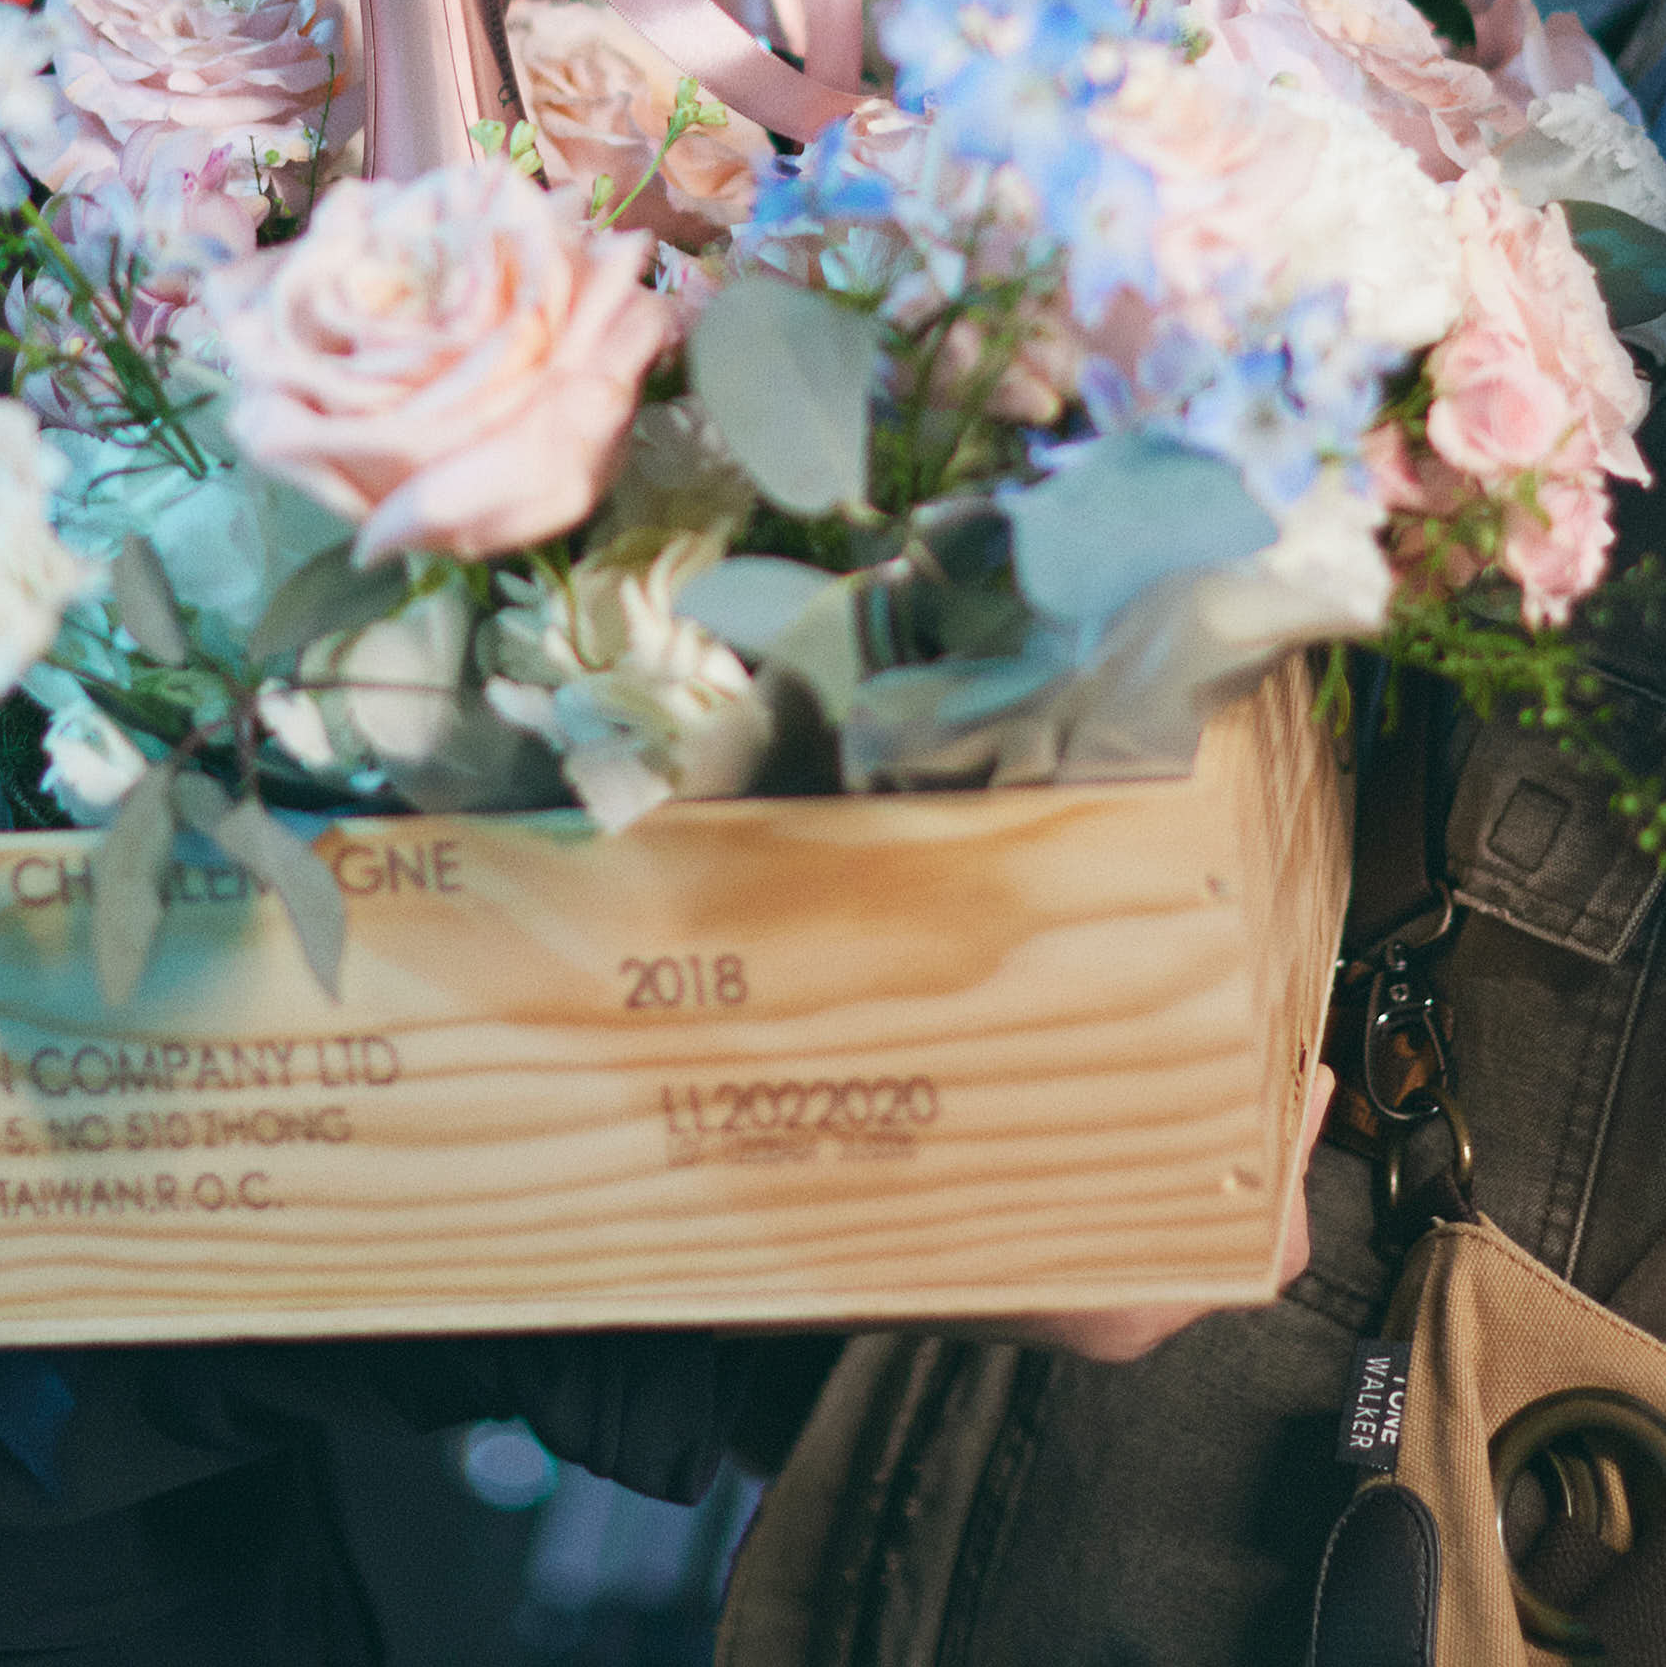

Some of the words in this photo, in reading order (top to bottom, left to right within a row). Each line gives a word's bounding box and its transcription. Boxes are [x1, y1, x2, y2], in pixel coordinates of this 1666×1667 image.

[12, 840, 464, 909] CHLEGNE
[619, 953, 749, 1010] 2018
[30, 1038, 294, 1098] COMPANY
[315, 1035, 402, 1088] LTD
[1348, 1357, 1391, 1449] WALKER
